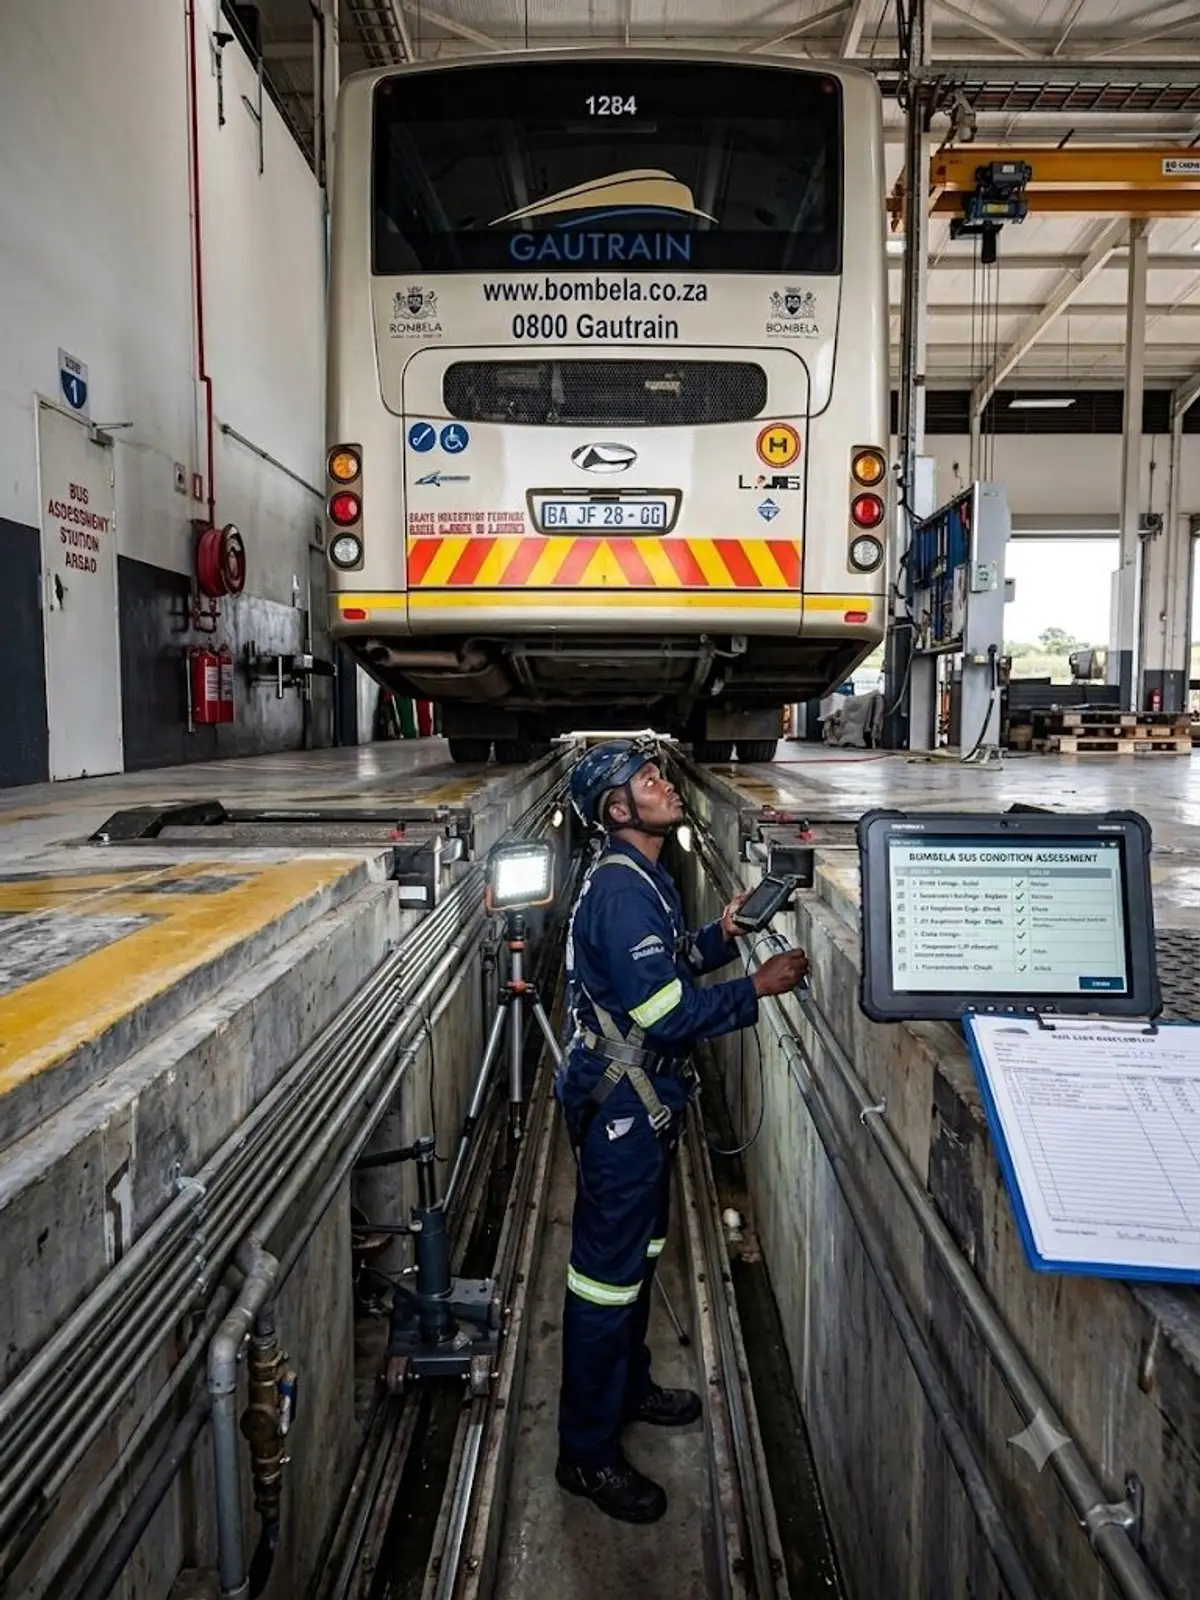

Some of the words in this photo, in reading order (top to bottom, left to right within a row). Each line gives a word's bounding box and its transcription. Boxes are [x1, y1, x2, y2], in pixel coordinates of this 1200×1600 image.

[586, 95, 637, 115] 1284
[509, 233, 692, 261] GAUTRAIN
[483, 277, 708, 302] www.bombela.co.za
[512, 314, 567, 339] 0800
[576, 314, 679, 339] Gautrain
[70, 379, 78, 404] 1
[69, 482, 89, 505] BUS
[577, 506, 597, 525] JF
[603, 506, 624, 525] 28
[979, 853, 1033, 863] CONDITION
[1035, 853, 1098, 863] ASSESSMENT
